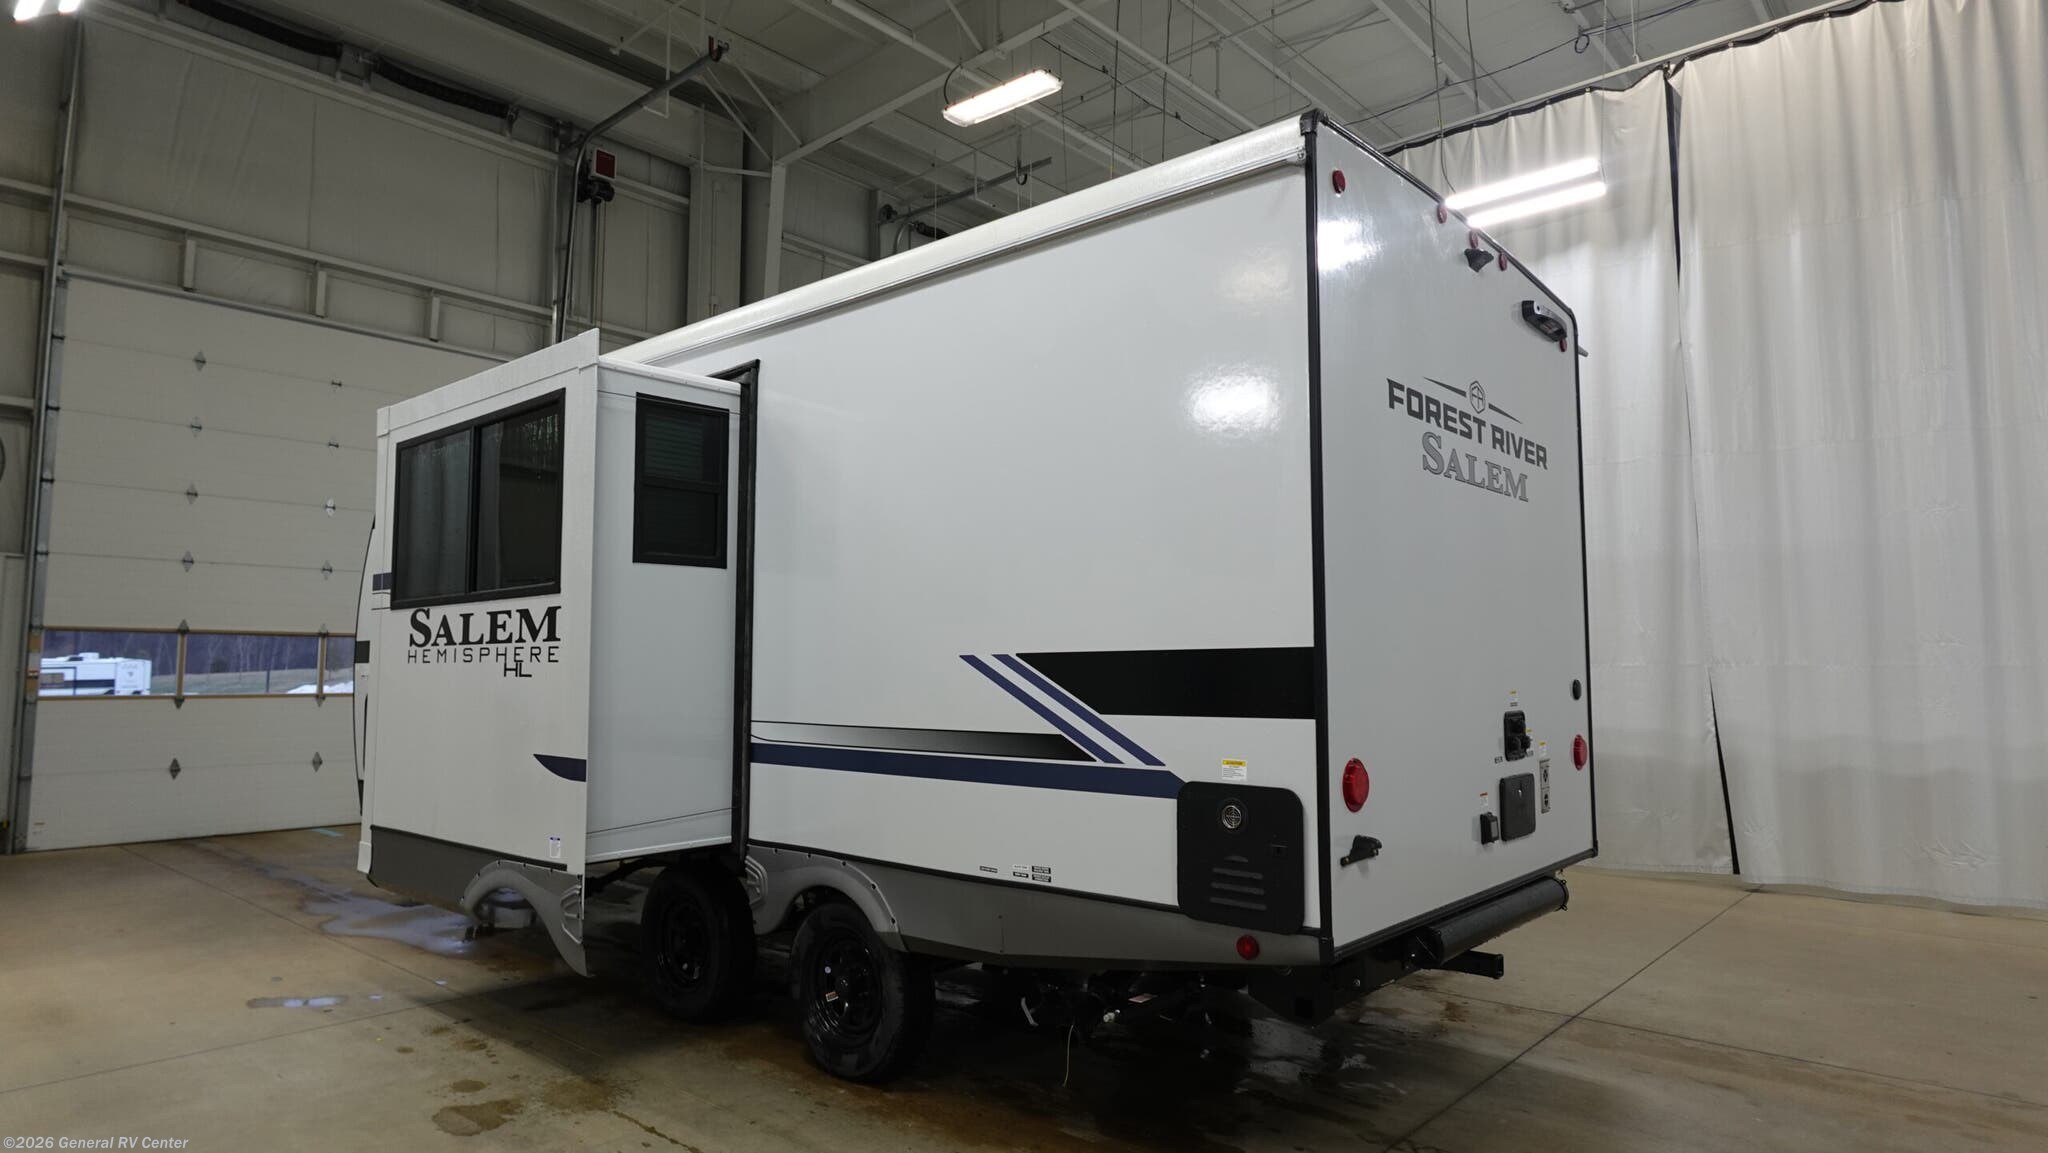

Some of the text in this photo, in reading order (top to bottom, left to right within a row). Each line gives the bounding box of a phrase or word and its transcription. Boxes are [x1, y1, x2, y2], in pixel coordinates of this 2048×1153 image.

[1386, 377, 1548, 470] FOREST RIVER
[1421, 431, 1529, 502] SALEM
[409, 605, 562, 648] SALEM
[407, 646, 560, 664] HEMISPHERE
[503, 661, 533, 678] HL
